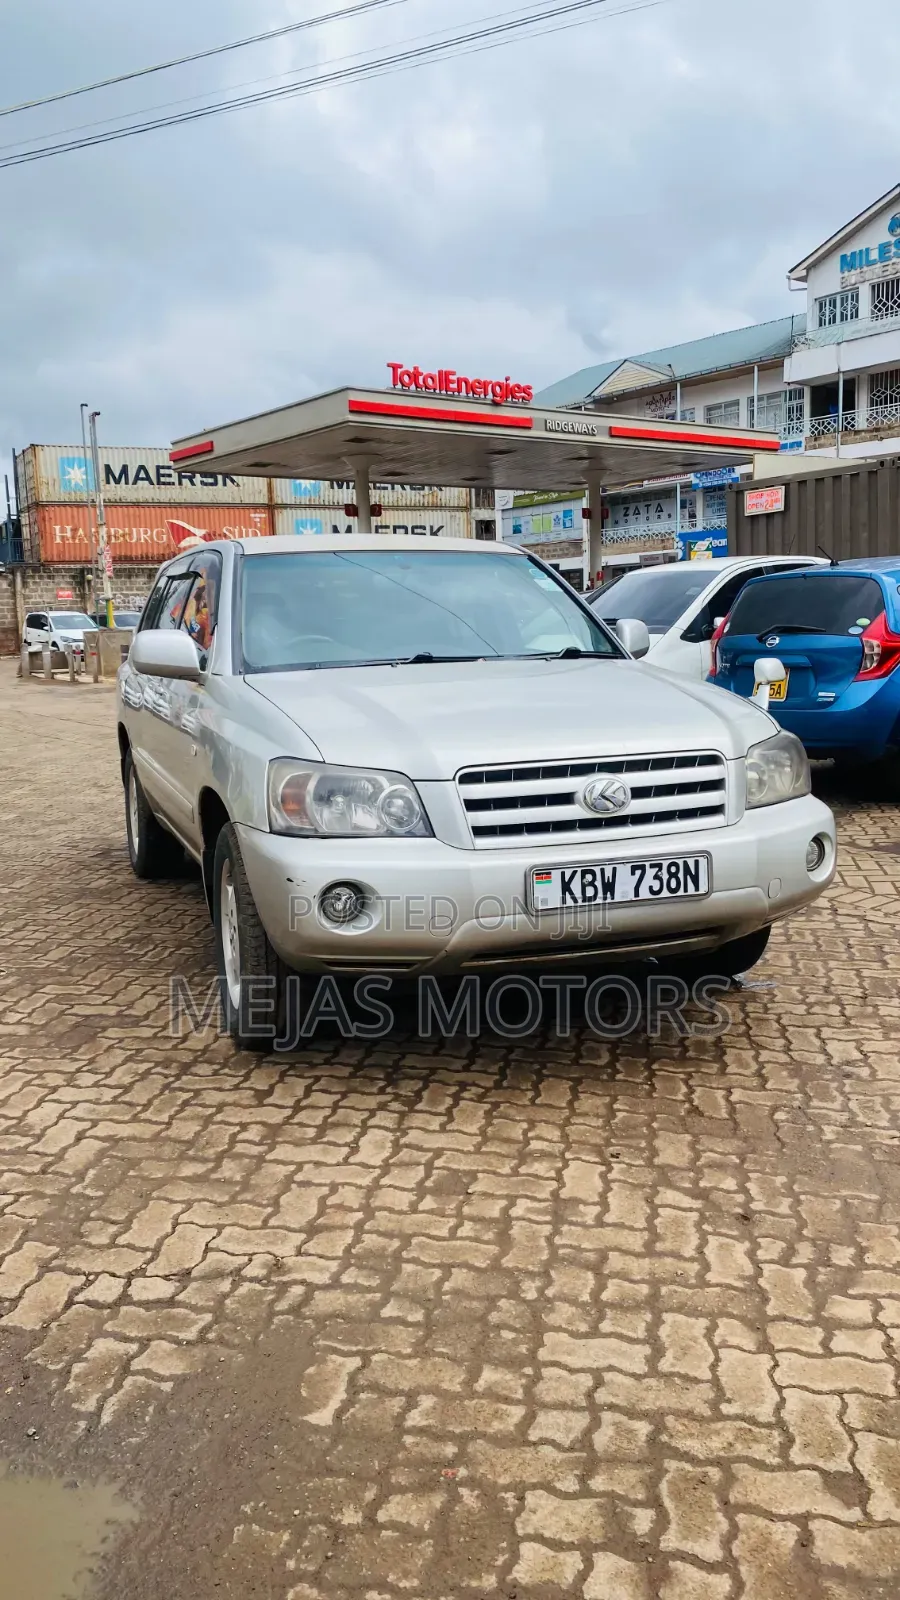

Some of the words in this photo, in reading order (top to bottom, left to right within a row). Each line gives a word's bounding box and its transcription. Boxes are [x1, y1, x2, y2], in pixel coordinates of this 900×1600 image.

[387, 362, 533, 405] TotalEnergies
[545, 419, 598, 436] RIDGEWAYS
[623, 502, 664, 518] ZATA
[747, 501, 764, 510] OPEN
[613, 513, 672, 525] MOTORS
[561, 866, 618, 905] KBW
[630, 858, 700, 899] 738N
